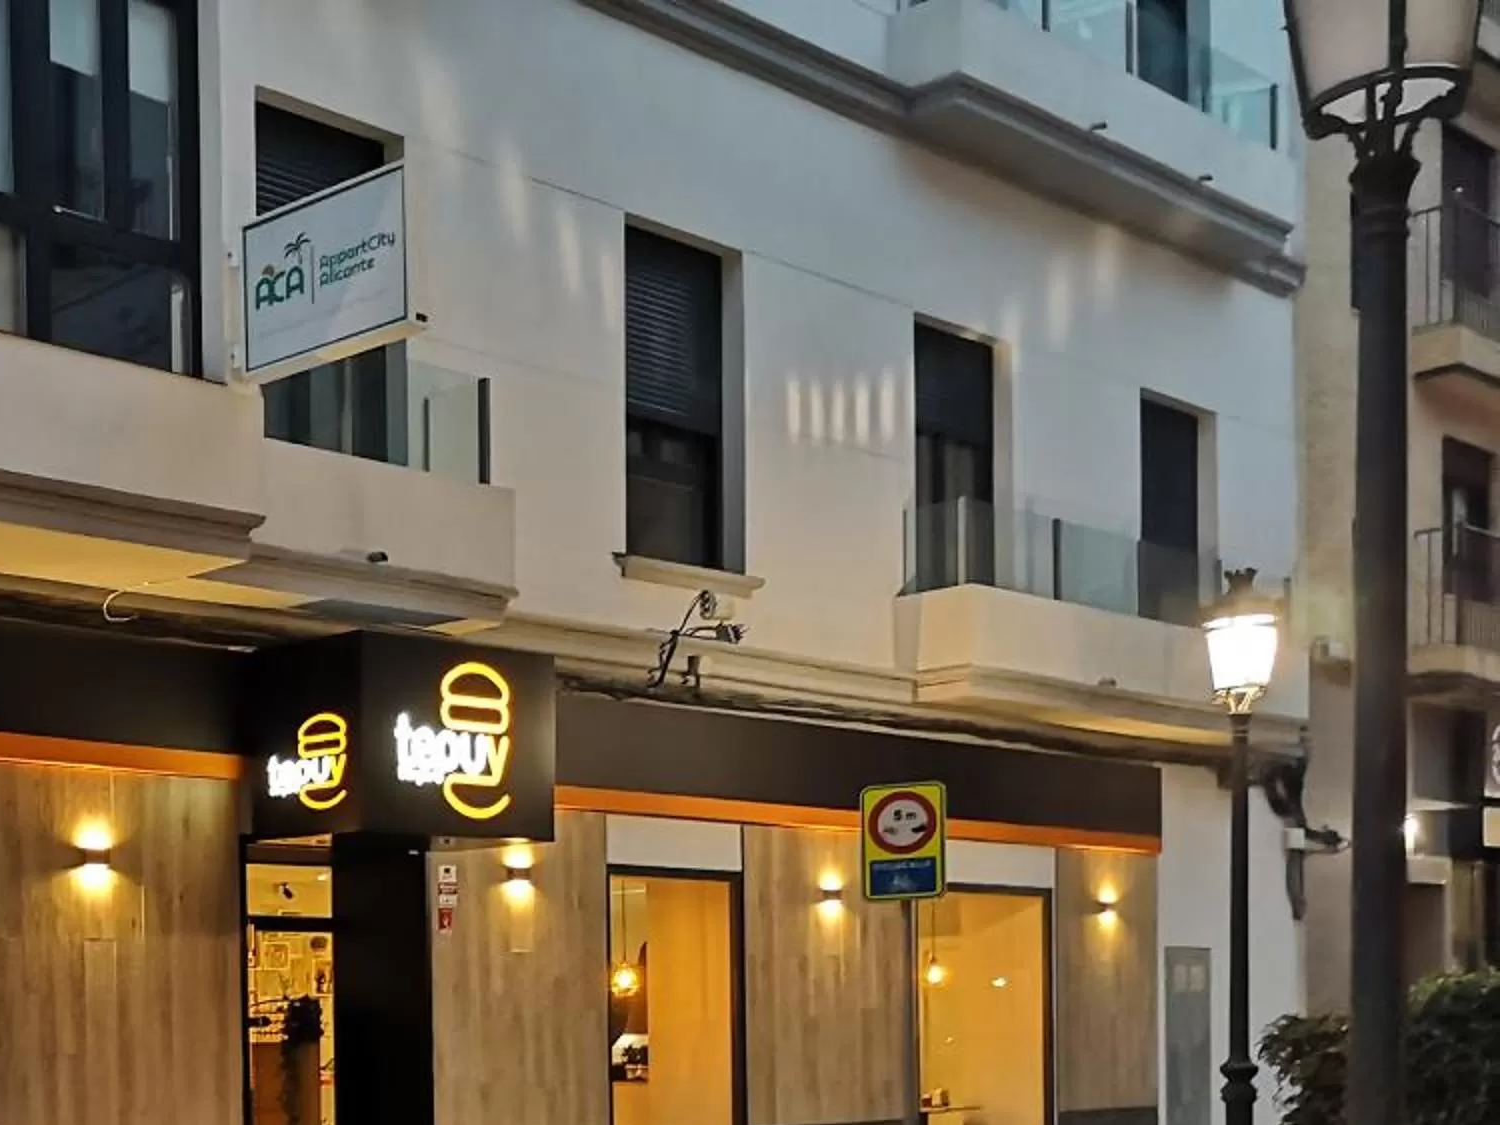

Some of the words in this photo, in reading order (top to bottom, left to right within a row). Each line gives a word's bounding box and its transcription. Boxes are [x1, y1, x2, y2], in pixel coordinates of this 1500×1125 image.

[256, 266, 305, 310] ACA
[320, 257, 375, 286] Alicante
[394, 711, 512, 820] tepuy
